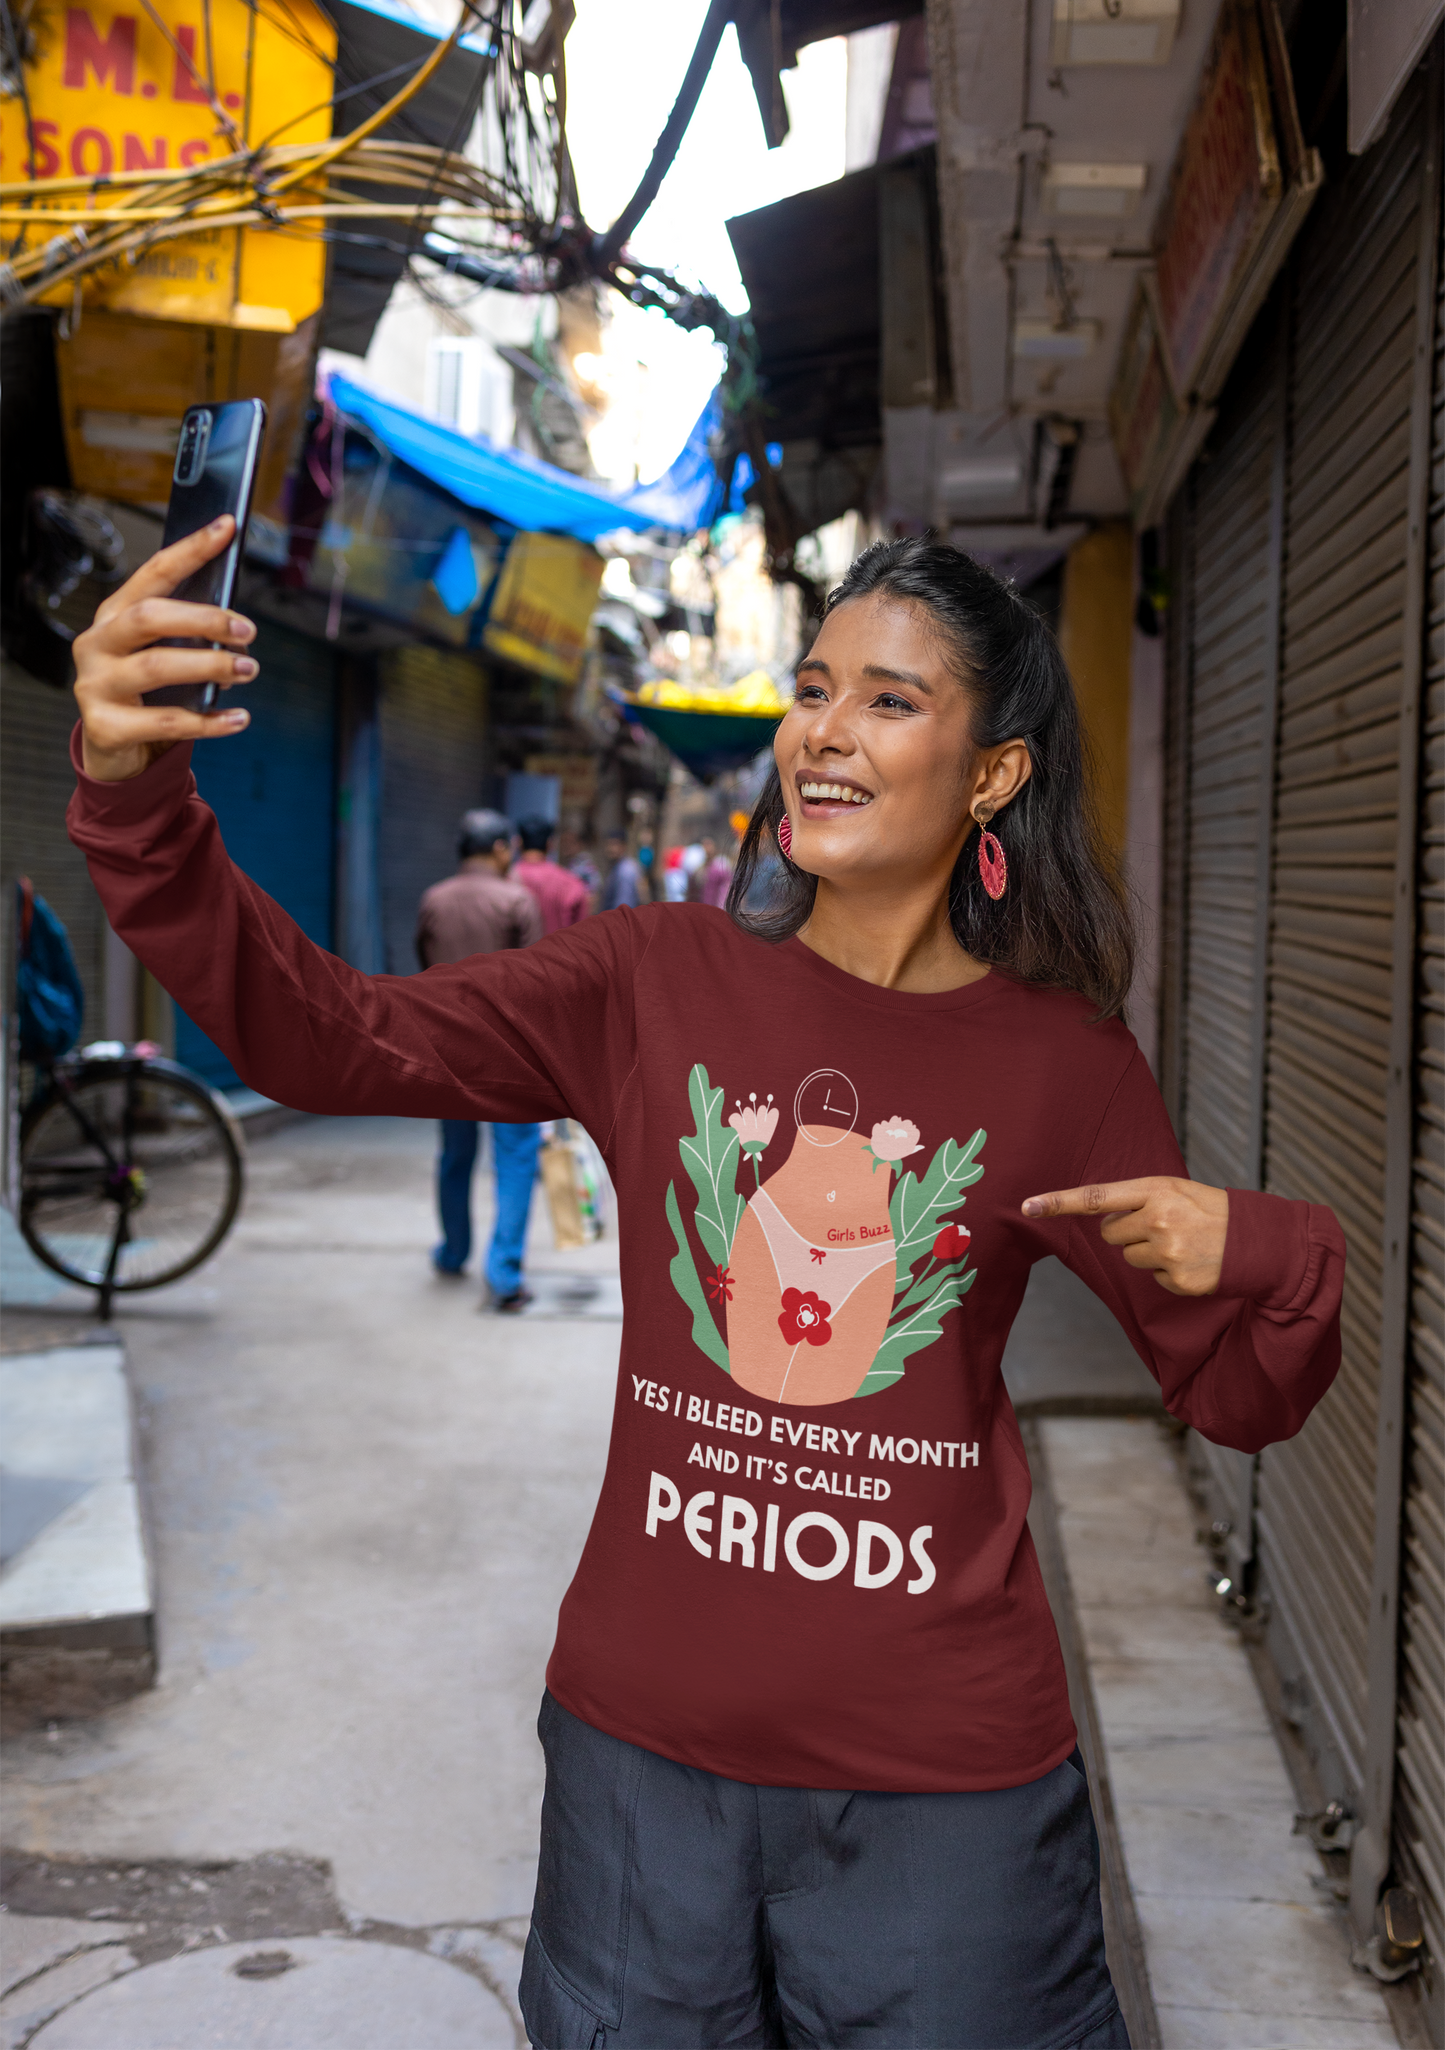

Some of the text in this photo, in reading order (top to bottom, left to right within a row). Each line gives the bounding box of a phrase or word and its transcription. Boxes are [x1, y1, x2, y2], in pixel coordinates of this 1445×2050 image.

[827, 1224, 891, 1242] Girls Buzz
[631, 1374, 980, 1468] YES I BLEED EVERY MONTH
[687, 1442, 892, 1501] AND IT’S CALLED
[645, 1470, 937, 1595] PERIODS
